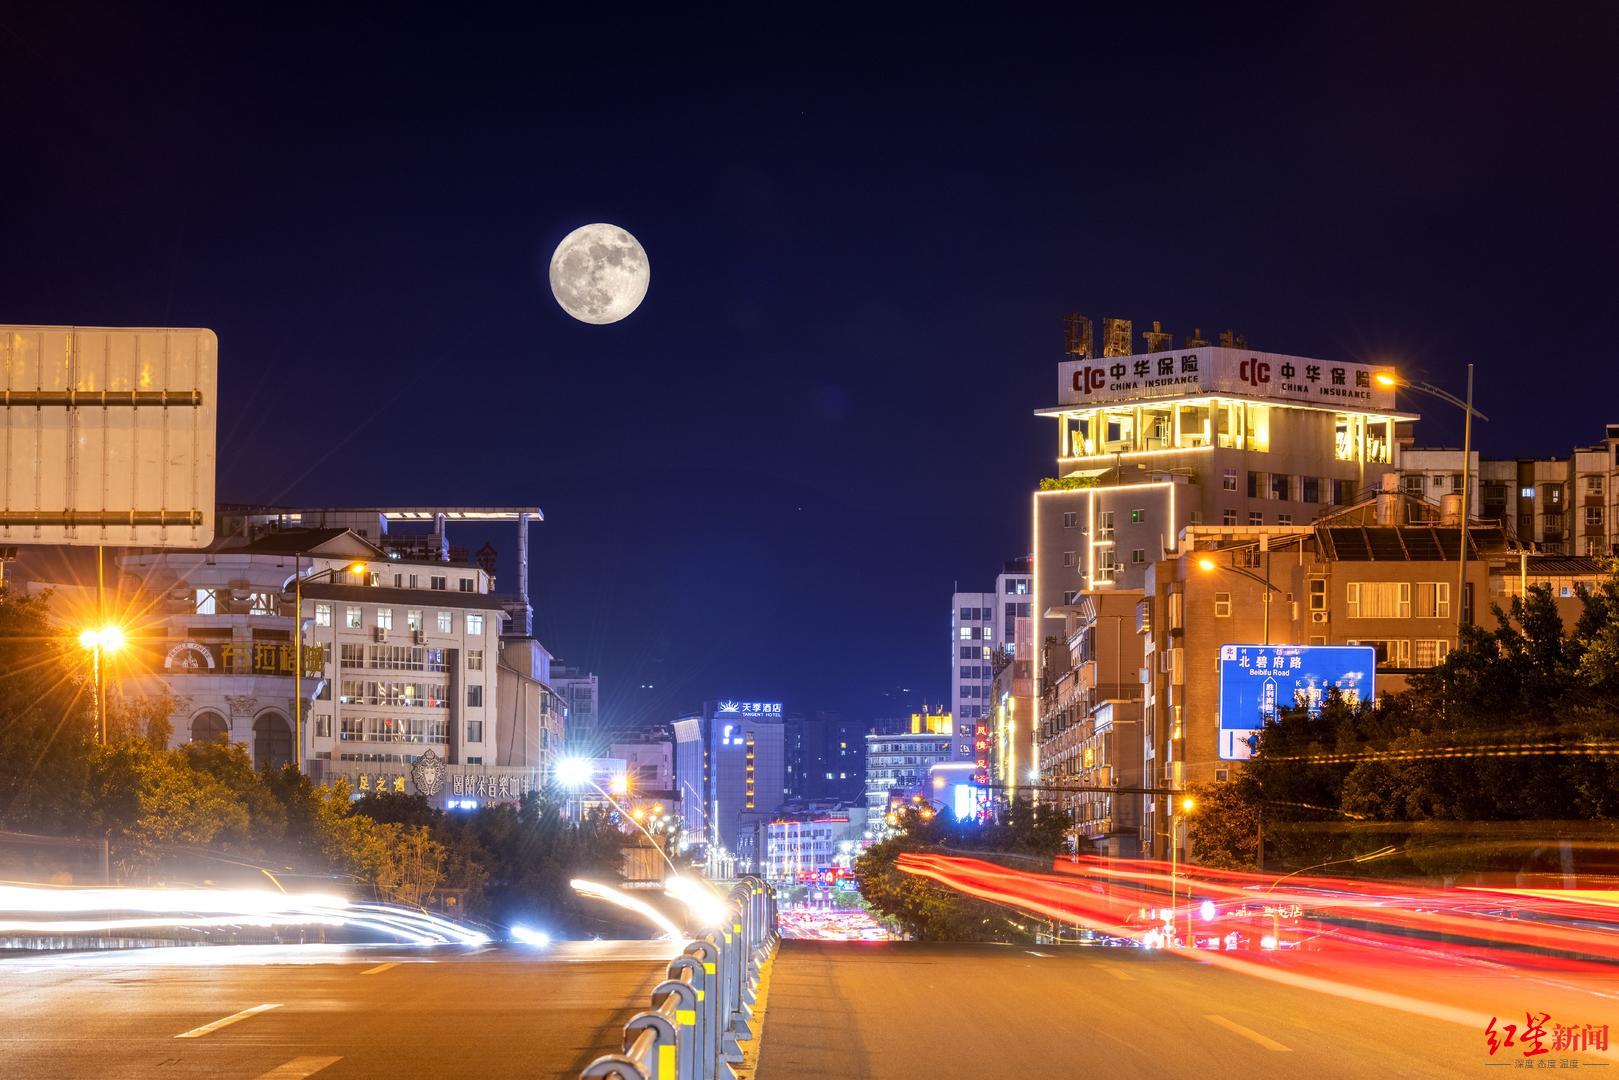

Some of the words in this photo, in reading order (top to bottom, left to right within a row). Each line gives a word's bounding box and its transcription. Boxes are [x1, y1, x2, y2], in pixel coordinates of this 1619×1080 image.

[1110, 355, 1199, 380] 中华保险
[1281, 362, 1370, 388] 中华保险
[1110, 380, 1138, 391] CHINA
[1145, 374, 1199, 388] INSURANCE
[1281, 382, 1309, 393] CHINA
[1320, 387, 1371, 400] INSURANCE
[1238, 656, 1302, 668] 北碧府路
[742, 703, 781, 713] 天季酒店
